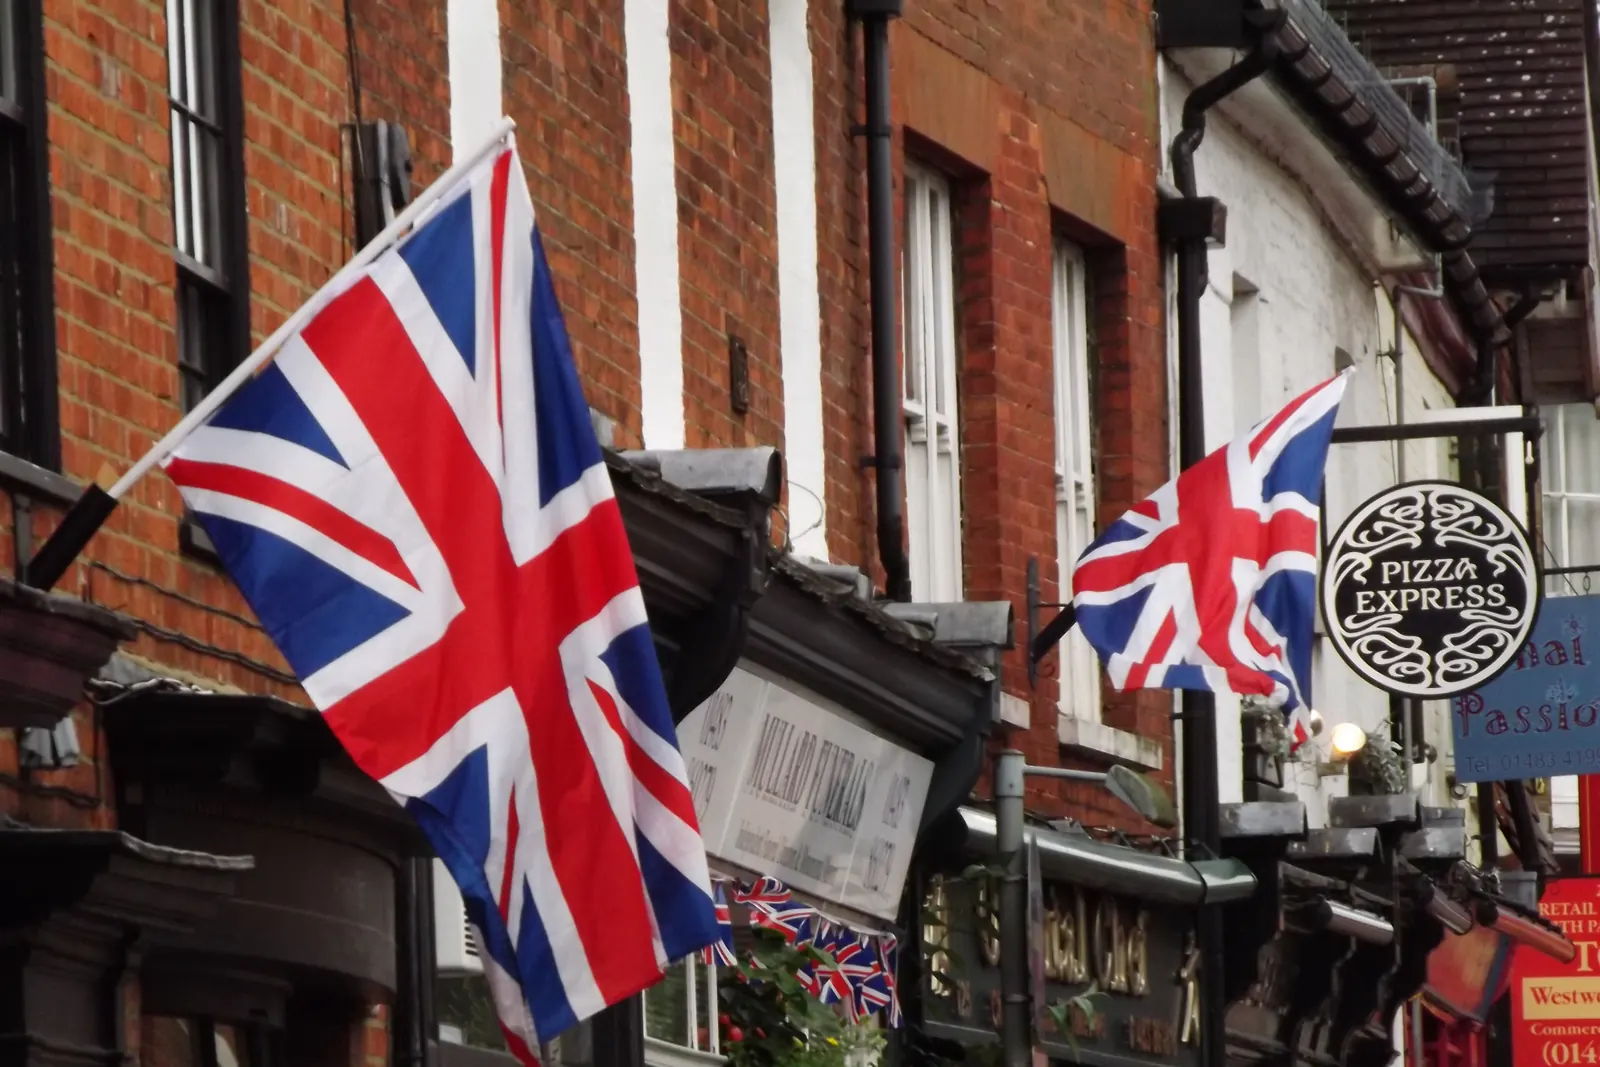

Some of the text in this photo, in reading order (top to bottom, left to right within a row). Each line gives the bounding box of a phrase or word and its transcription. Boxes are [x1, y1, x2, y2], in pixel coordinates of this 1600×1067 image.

[1381, 557, 1478, 584] PIZZA
[1356, 583, 1506, 614] EXPRESS
[1466, 756, 1489, 774] Tel
[1501, 752, 1556, 772] 01483
[1538, 902, 1597, 916] RETAIL
[1588, 920, 1600, 933] P
[1573, 941, 1600, 972] T
[1542, 1040, 1600, 1067] (014
